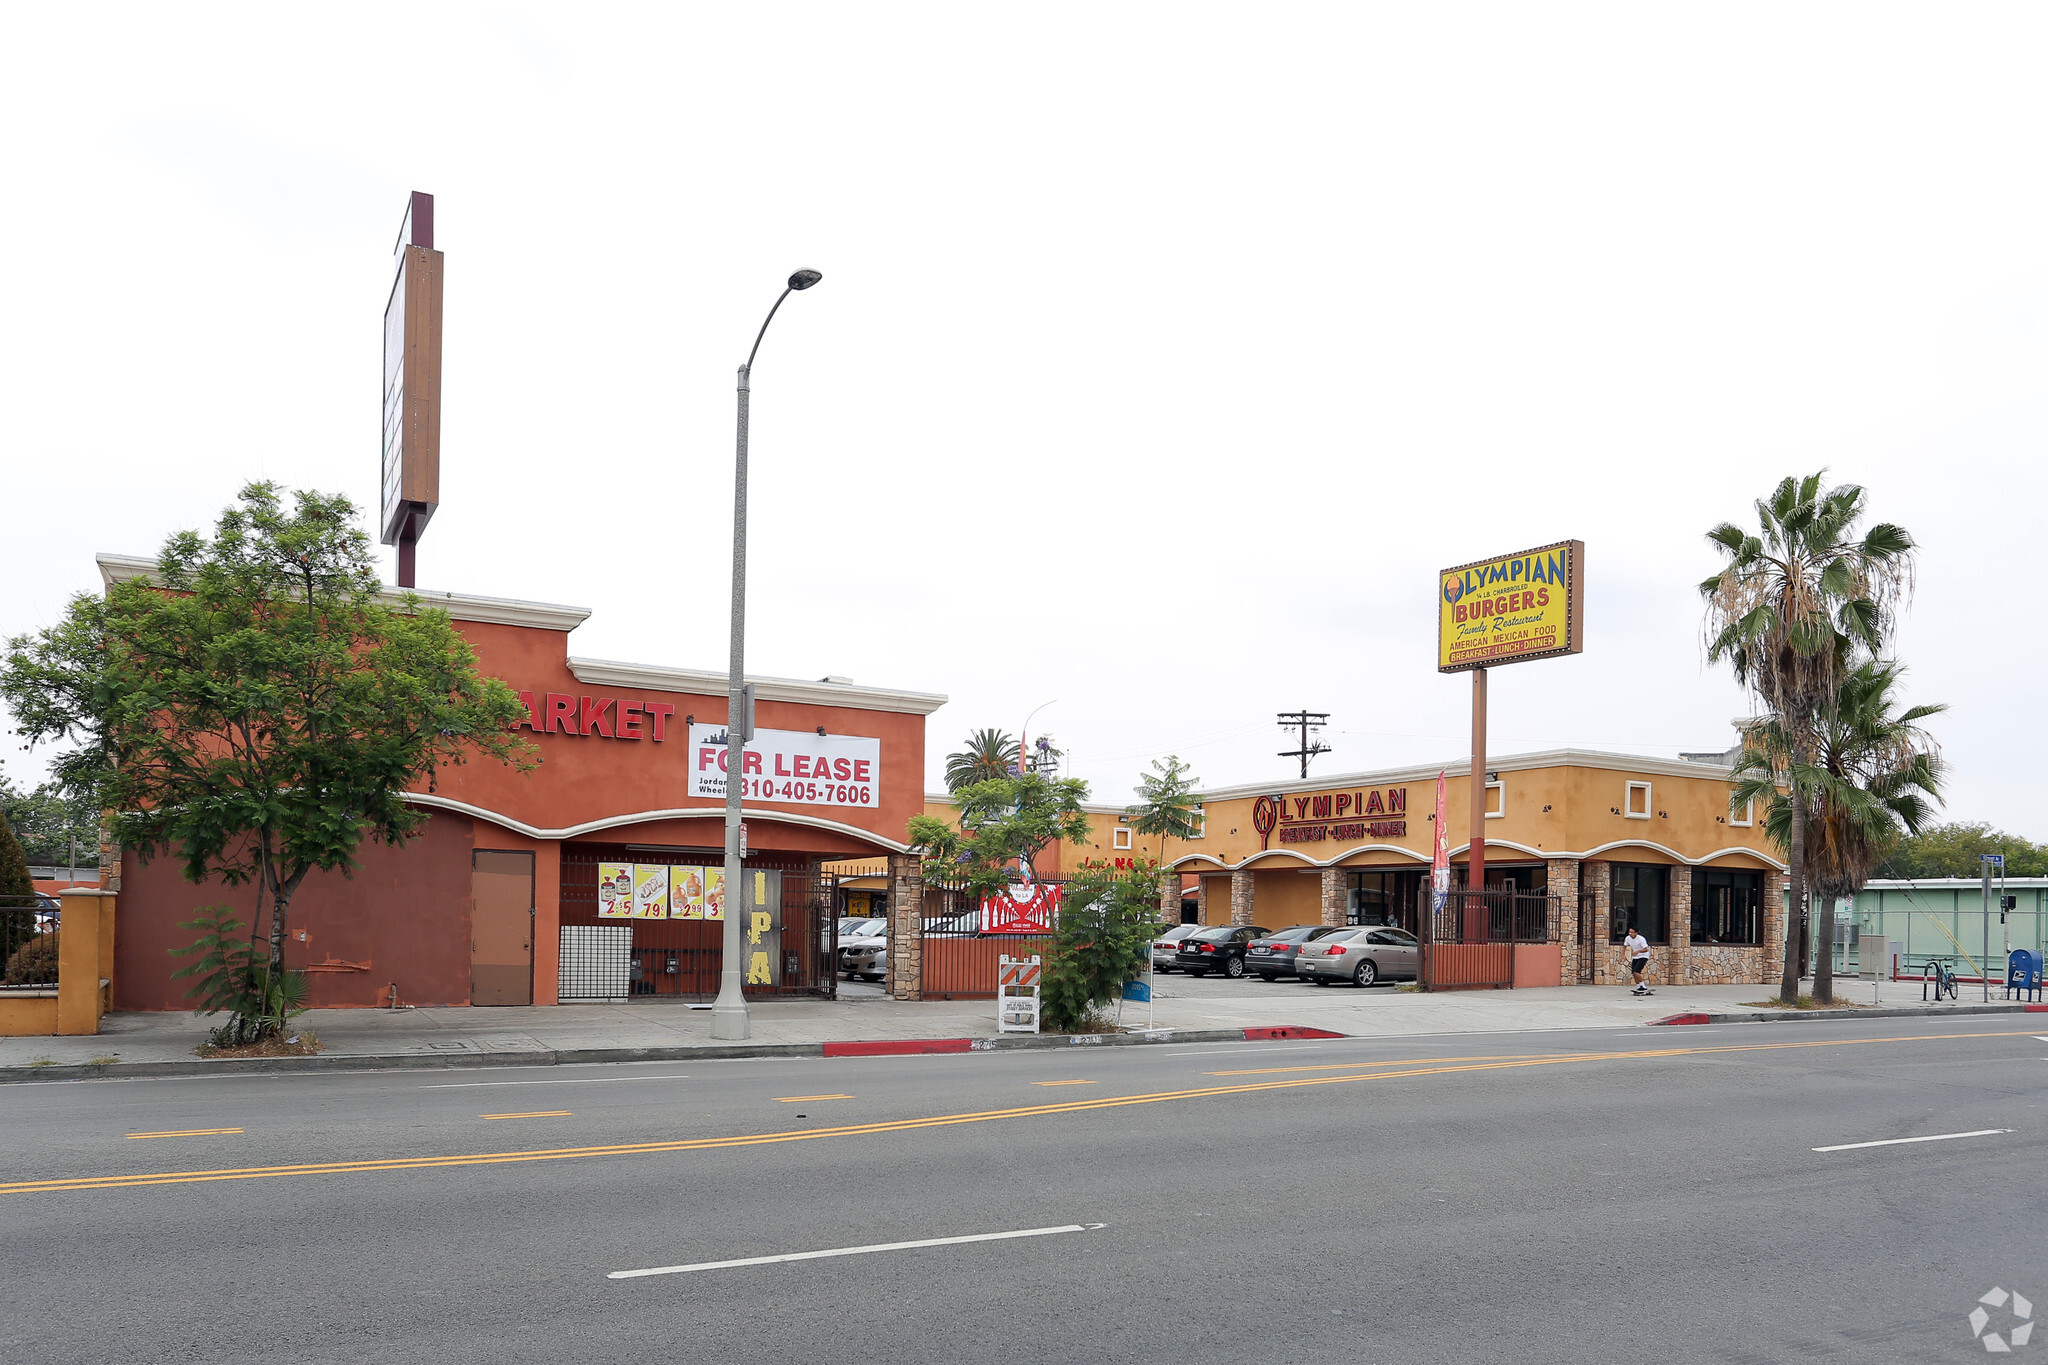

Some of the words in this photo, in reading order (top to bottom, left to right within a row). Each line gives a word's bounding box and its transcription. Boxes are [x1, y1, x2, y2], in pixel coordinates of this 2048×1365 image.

[1444, 549, 1565, 604] OLYMPIAN
[1493, 584, 1528, 597] CHARBROILED
[1456, 587, 1550, 623] BURGERS
[1449, 637, 1488, 651] AMERICAN
[1493, 629, 1529, 643] MEXICAN
[1534, 624, 1557, 637] FOOD
[1456, 623, 1488, 640] Family
[1492, 610, 1544, 633] Restaurant
[1450, 648, 1491, 662] BREAKFAST
[1494, 643, 1520, 655] LUNCH
[1524, 636, 1554, 649] DINNER
[507, 690, 675, 742] ARKET
[774, 753, 871, 783] LEASE
[699, 785, 728, 794] Wheel
[1253, 788, 1407, 836] OLYMPIAN
[1279, 825, 1327, 843] BREAKFAST
[1332, 823, 1364, 840] LUNCH
[1369, 820, 1407, 838] DINNER
